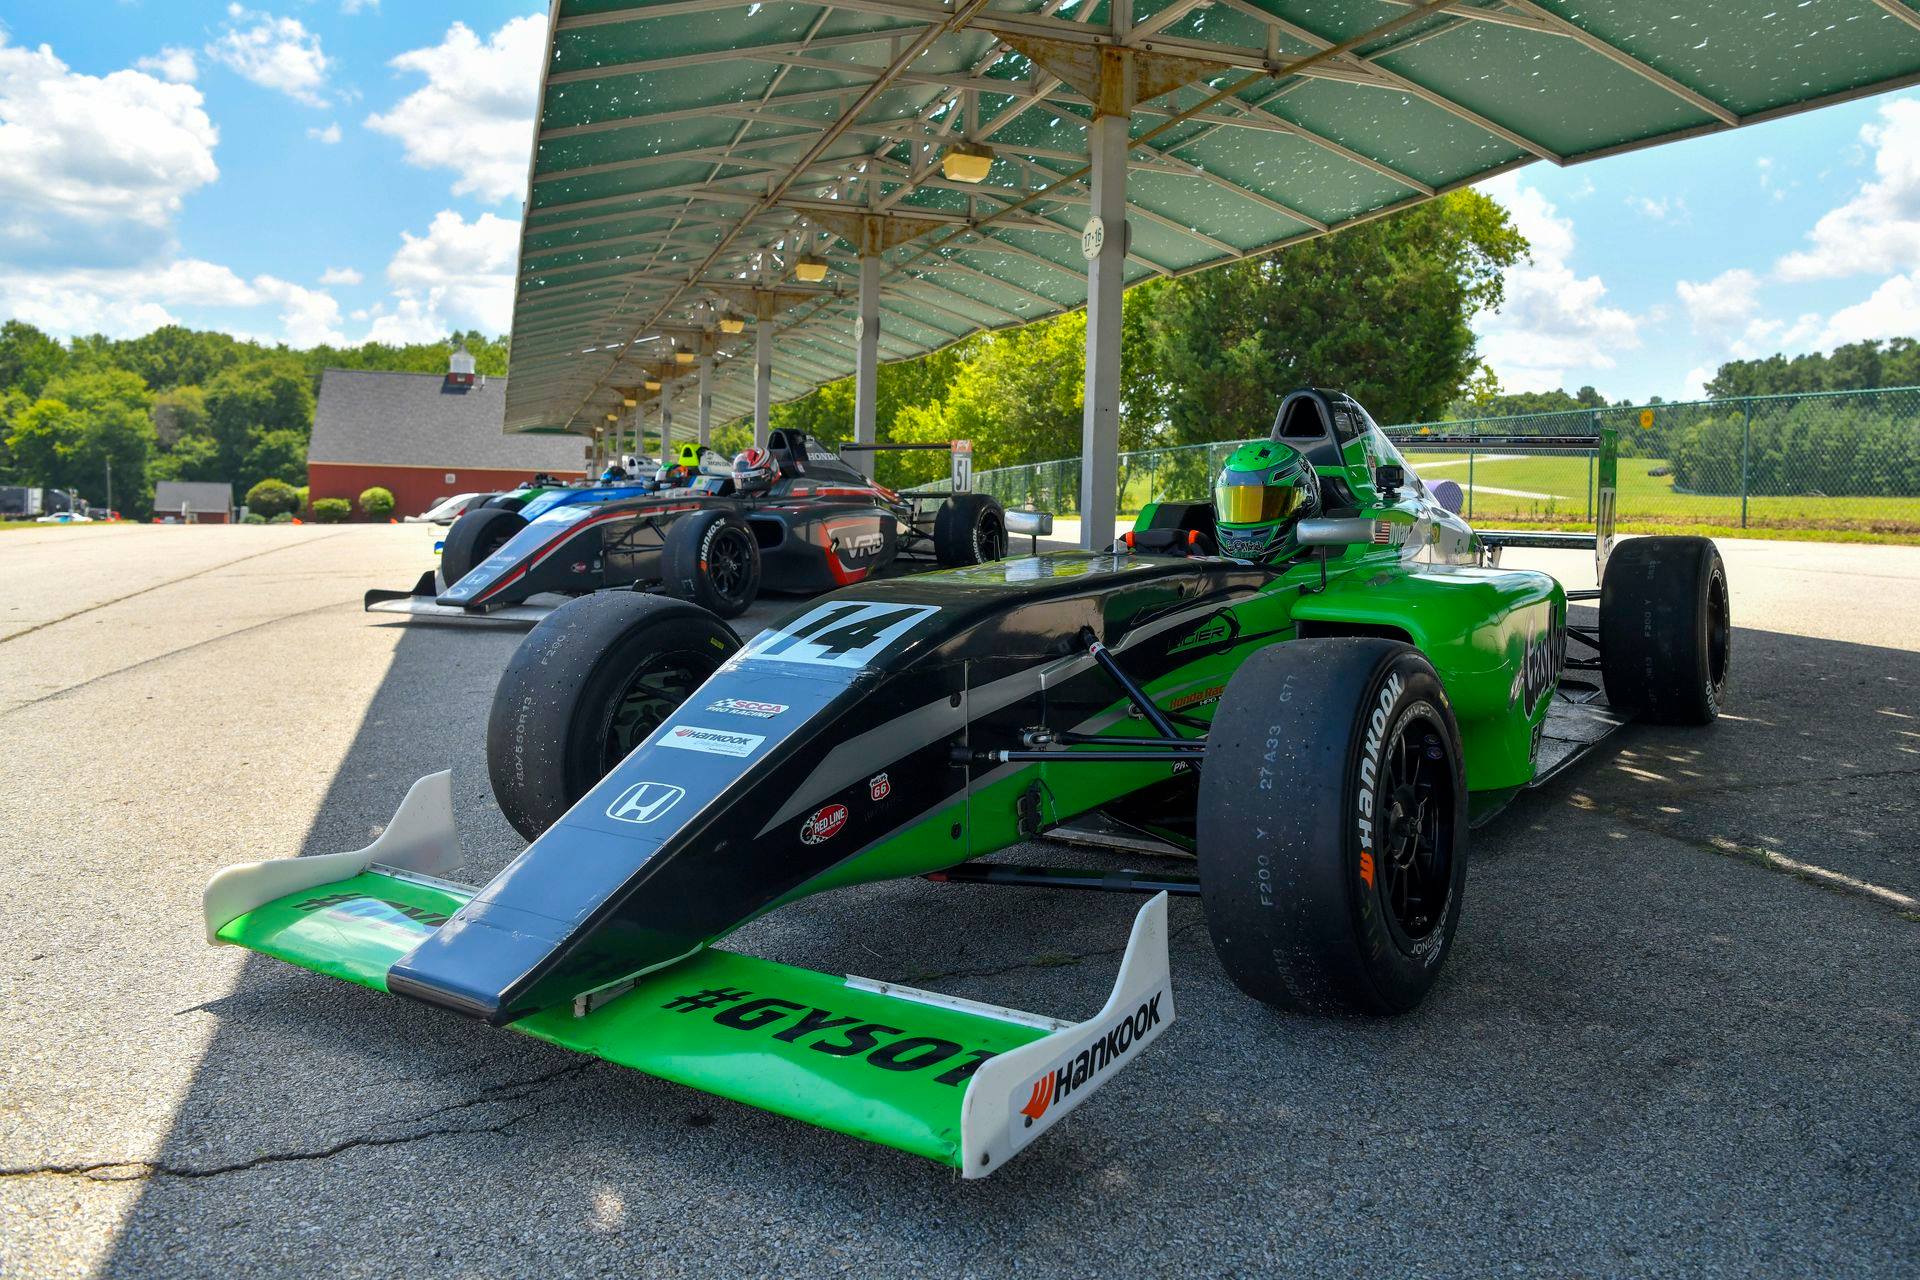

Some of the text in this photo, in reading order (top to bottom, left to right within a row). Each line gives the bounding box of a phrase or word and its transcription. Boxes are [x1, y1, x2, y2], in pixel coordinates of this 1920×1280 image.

[807, 452, 841, 461] HONDA
[845, 532, 884, 559] VRD
[761, 604, 929, 660] 14
[1205, 686, 1225, 698] Rac
[705, 706, 774, 719] PRO RACING
[733, 699, 782, 713] SCCA
[873, 783, 887, 798] 66
[814, 808, 845, 834] RED LINE
[1257, 854, 1274, 906] F200
